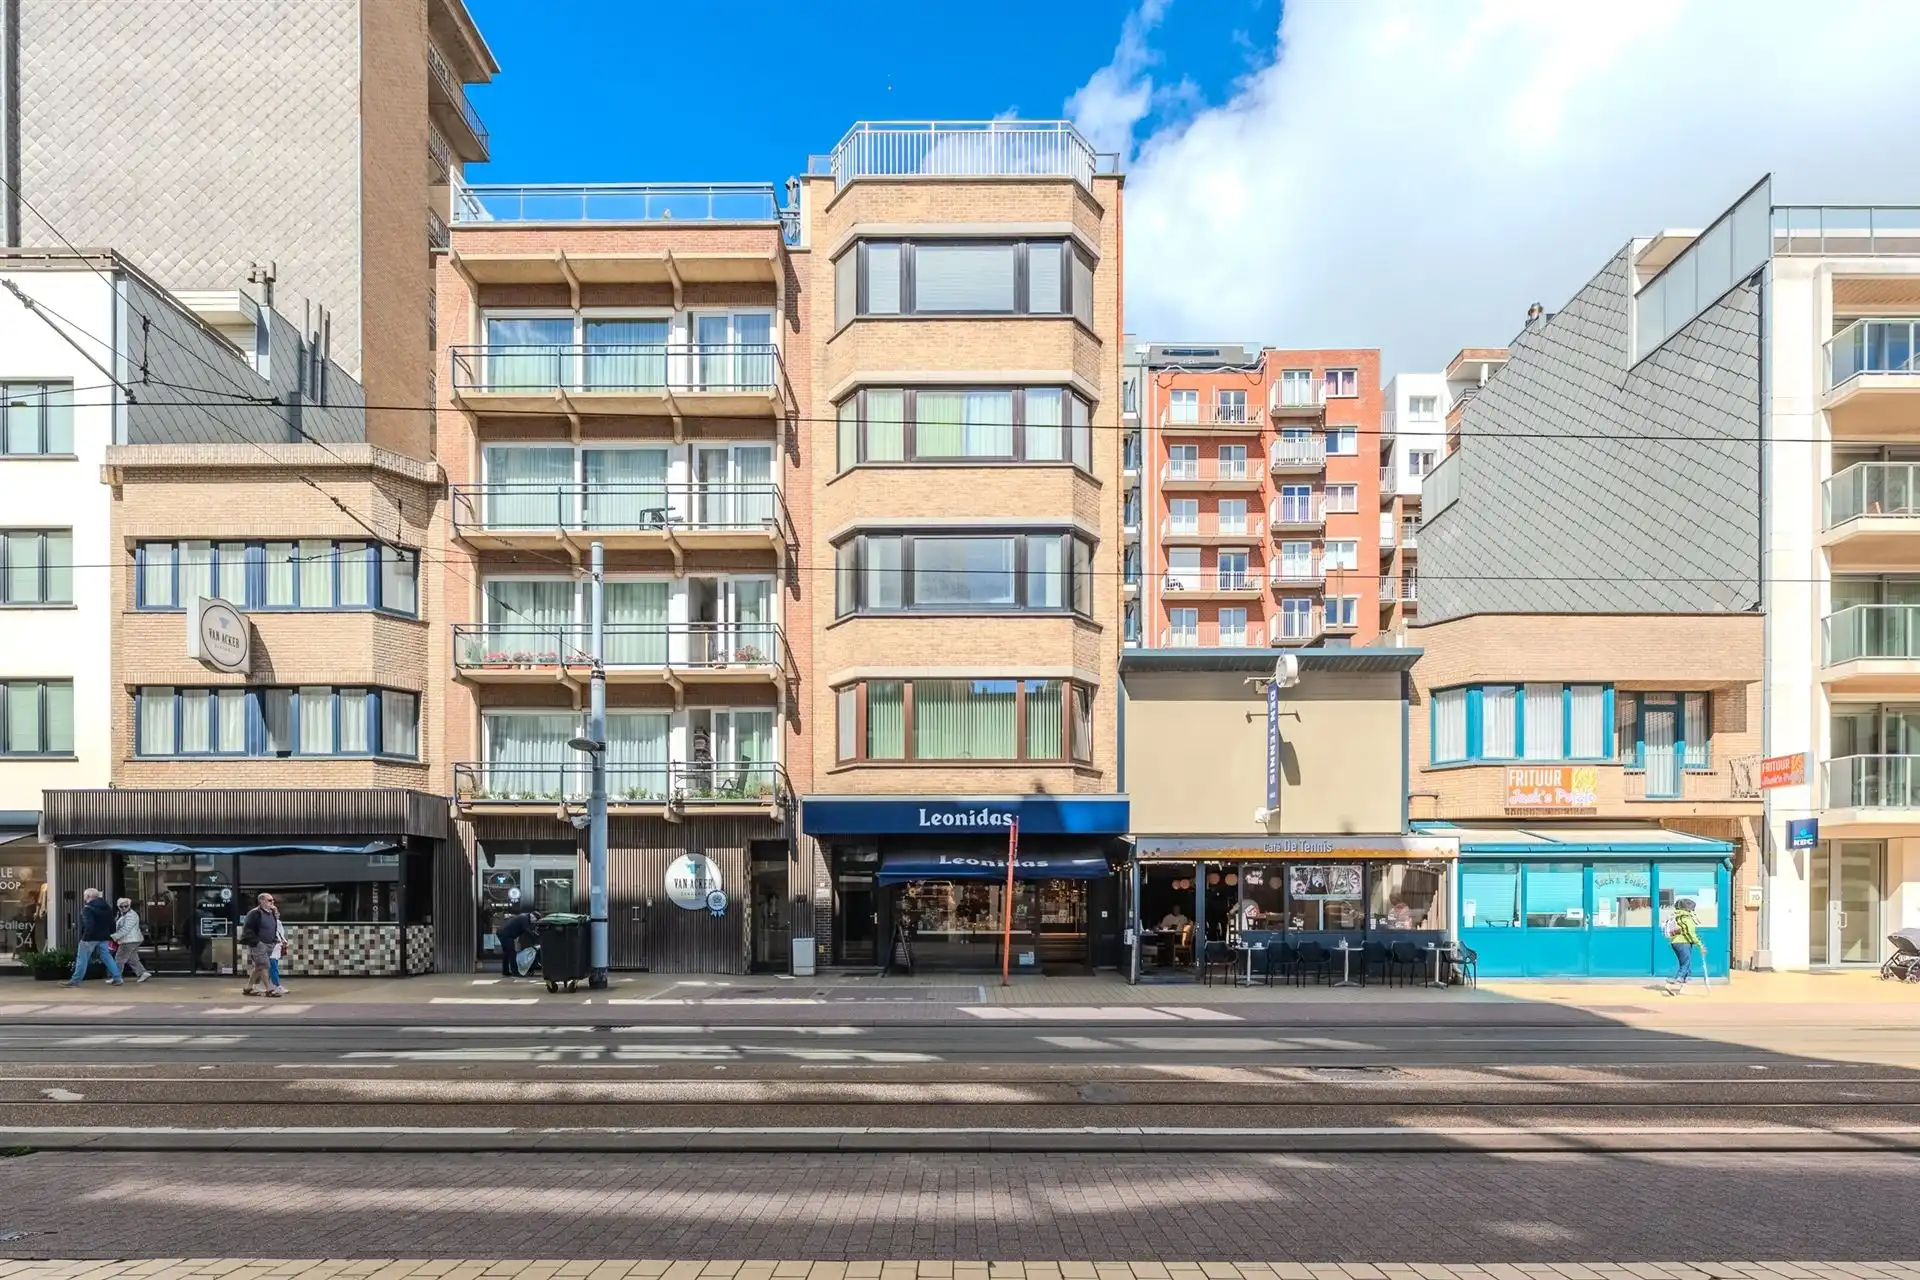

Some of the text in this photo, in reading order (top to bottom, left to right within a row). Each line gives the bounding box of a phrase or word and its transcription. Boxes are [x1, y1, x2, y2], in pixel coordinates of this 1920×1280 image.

[208, 627, 240, 649] VAN ACKER
[1763, 758, 1790, 773] FRITUUR
[1509, 769, 1561, 787] FRITUUR
[919, 807, 1013, 827] Leonidas
[1284, 839, 1297, 853] De
[1300, 839, 1333, 853] Tennis
[1793, 838, 1814, 846] KBC
[939, 855, 1049, 867] Leonidas
[674, 878, 713, 889] VAN ACKER
[16, 932, 33, 949] 34
